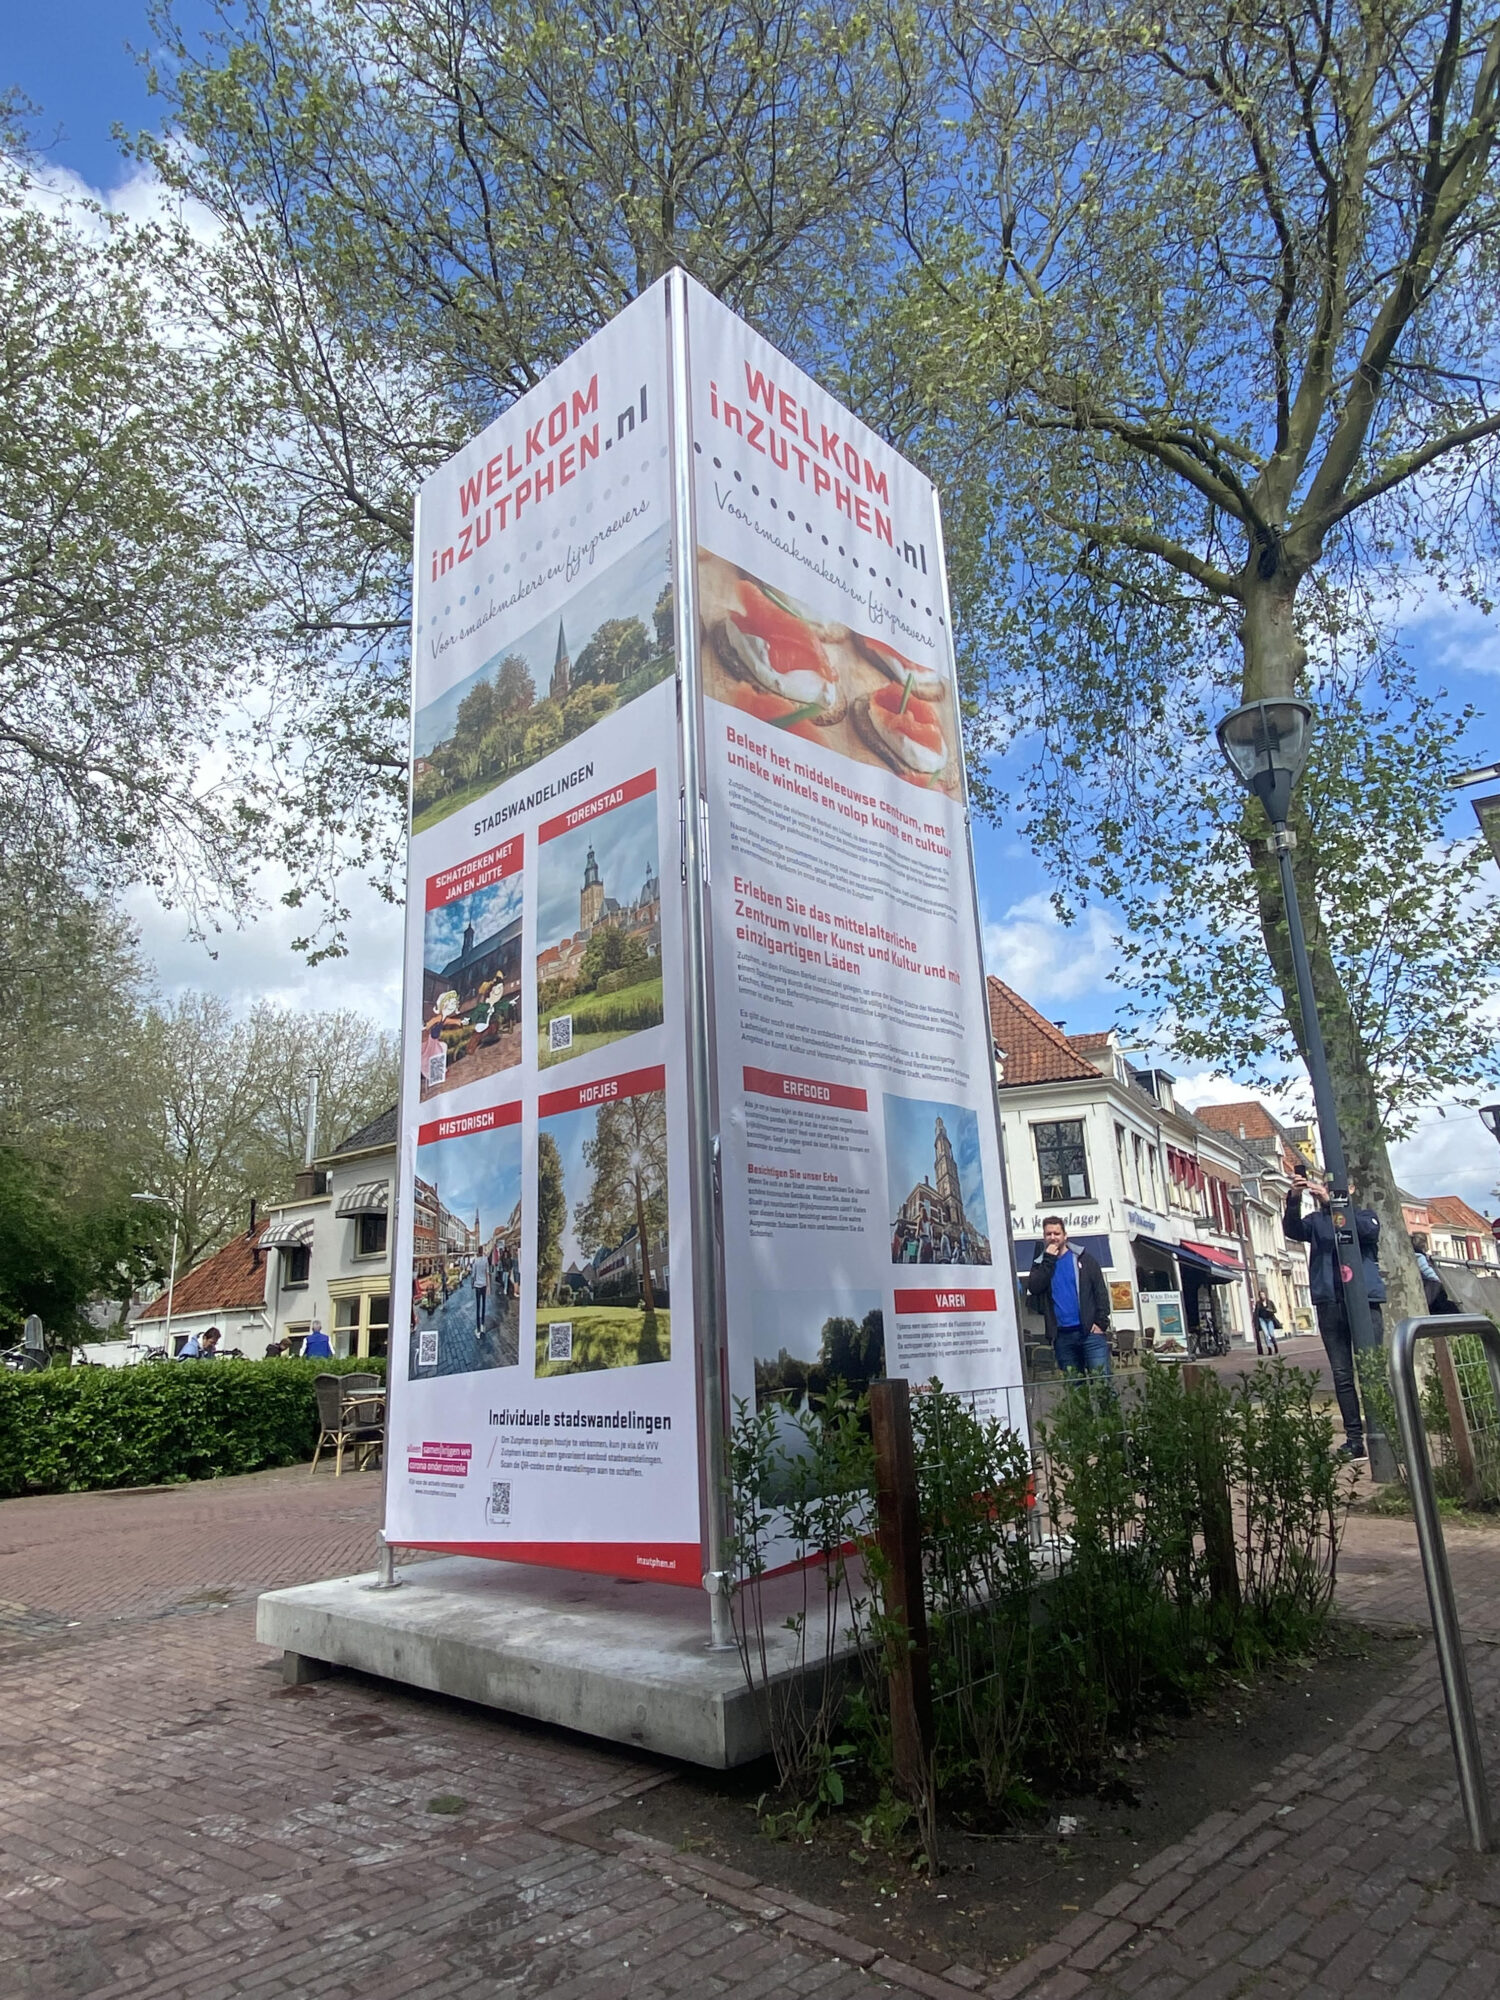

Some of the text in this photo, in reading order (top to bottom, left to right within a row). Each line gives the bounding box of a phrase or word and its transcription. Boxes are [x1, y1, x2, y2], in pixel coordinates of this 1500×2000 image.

[460, 374, 598, 518] WELKOM
[745, 360, 889, 505] WELKOM
[432, 384, 648, 582] inZUTPHEN.nl
[710, 380, 928, 576] inZUTPHEN.nl
[431, 499, 650, 659] Voor smaakmakers en fijnproevers
[715, 481, 936, 648] Voor smaakmakers en fijnproevers
[474, 762, 594, 837] STADSWANDELINGEN
[727, 726, 767, 756] Beleef
[771, 747, 791, 769] het
[794, 762, 877, 807] middeleeuwse
[880, 800, 921, 833] centrum,
[924, 824, 945, 838] met
[727, 752, 769, 781] unieke
[772, 773, 819, 802] winkels
[822, 796, 835, 812] en
[838, 802, 868, 827] volop
[872, 812, 899, 837] kunst
[901, 830, 913, 846] en
[566, 789, 623, 827] TORENSTAD
[436, 843, 513, 888] SCHATZOEKEN MET
[446, 865, 503, 900] JAN EN JUTTE
[734, 876, 917, 953] Erleben Sie das mittelalterliche
[735, 900, 790, 933] Zentrum
[793, 921, 828, 944] voller
[831, 932, 865, 956] Kunst
[868, 944, 890, 963] und
[892, 950, 922, 973] Kultur
[924, 961, 946, 979] und
[736, 926, 861, 975] einzigartigen Läden
[579, 1082, 618, 1103] HOFJES
[783, 1080, 830, 1100] ERFGOED
[439, 1112, 494, 1136] HISTORISCH
[748, 1163, 788, 1179] Besichtigen
[789, 1169, 800, 1179] Sie
[803, 1171, 821, 1180] unser
[936, 1294, 966, 1307] VAREN
[489, 1409, 672, 1434] Individuele stadswandelingen
[637, 1441, 645, 1450] de
[637, 1555, 676, 1570] inzutphen.nl
